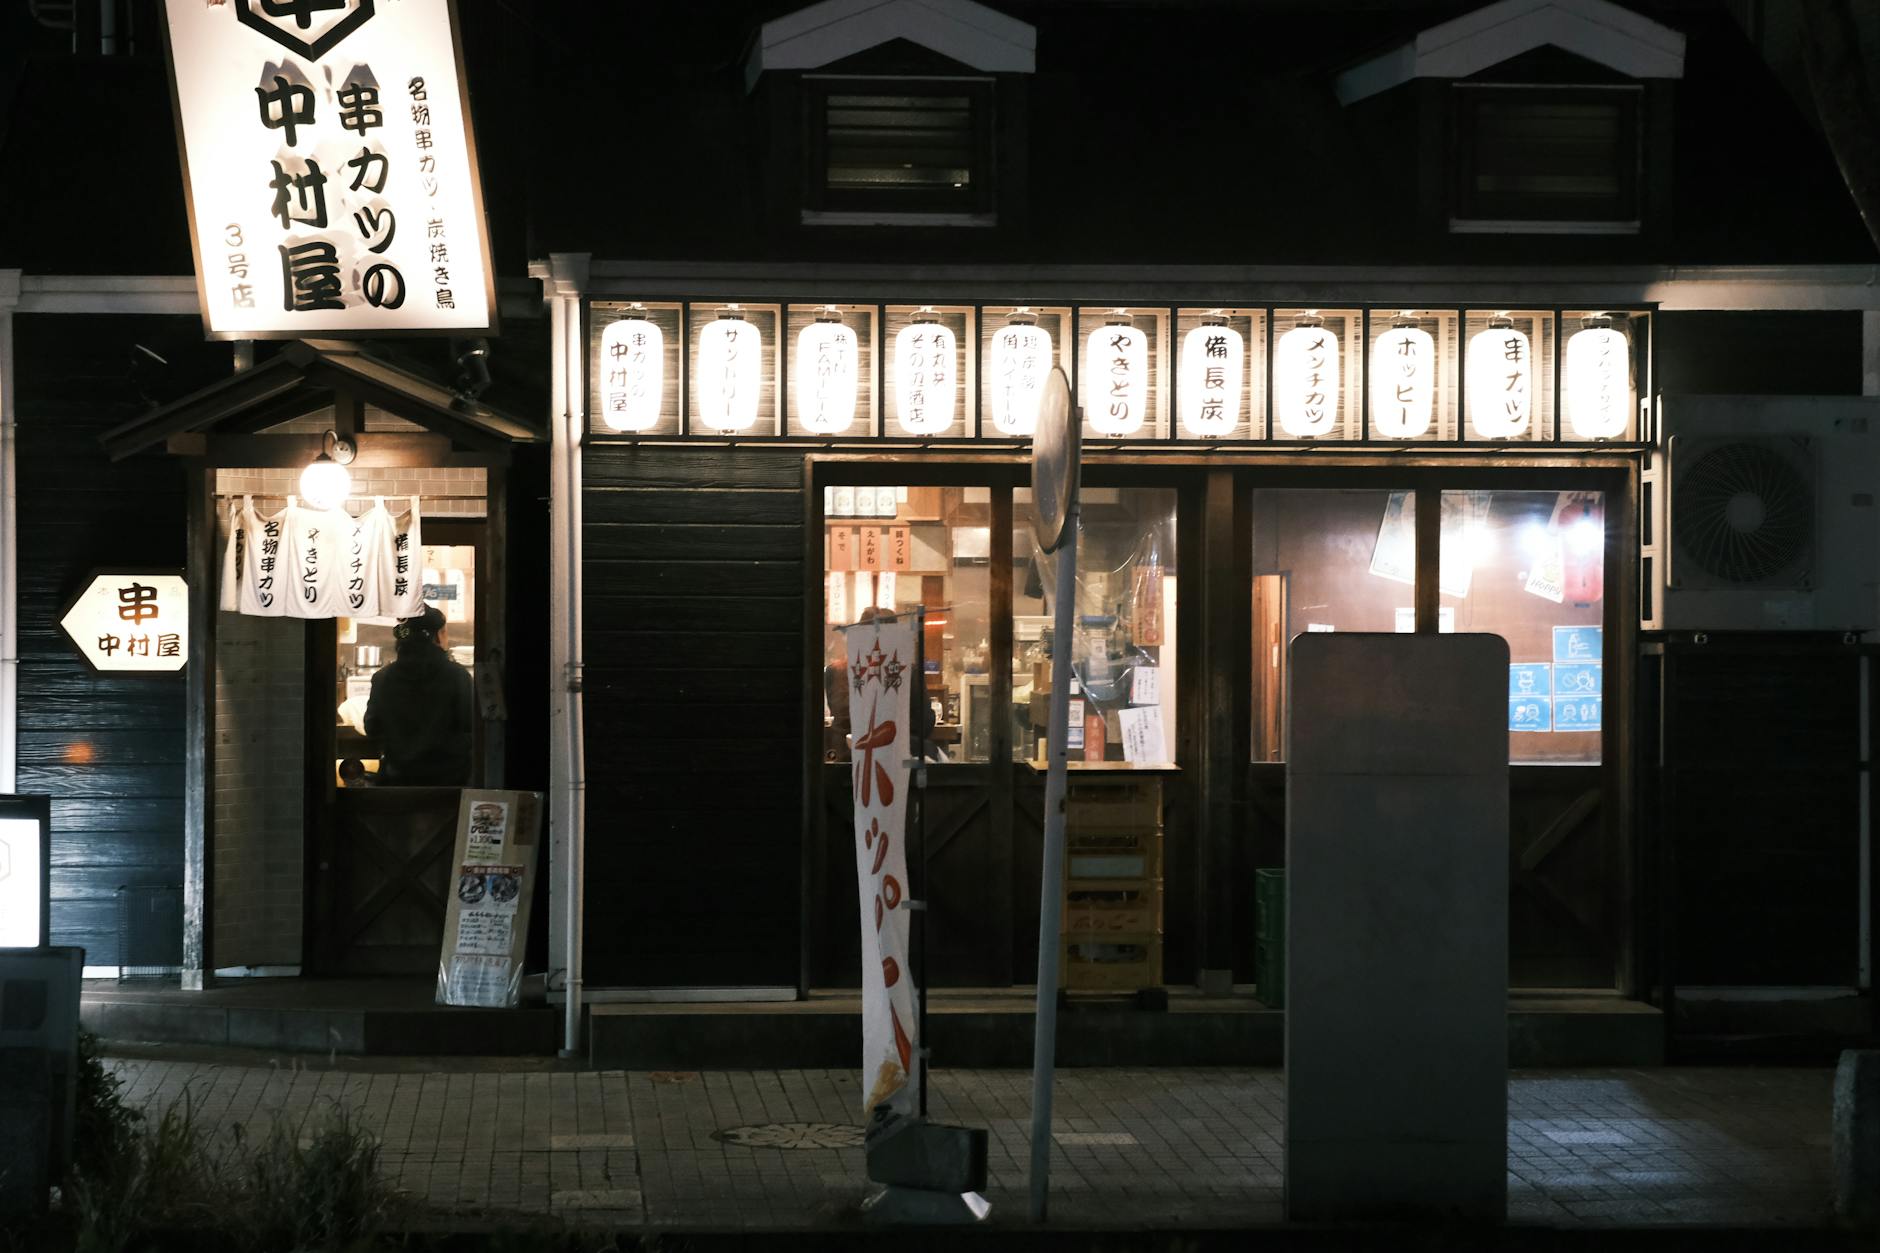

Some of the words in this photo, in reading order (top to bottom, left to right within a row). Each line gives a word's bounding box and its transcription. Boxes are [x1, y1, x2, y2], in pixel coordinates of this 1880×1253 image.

[254, 75, 346, 312] 中村屋
[336, 83, 406, 311] 串カツの
[224, 222, 255, 309] 3号店
[609, 341, 628, 412] 中村屋
[1109, 334, 1131, 420] やきとり
[1200, 335, 1228, 421] 備長炭
[1304, 337, 1326, 424] メンチカツ
[258, 520, 279, 608] 名物串カツ
[303, 527, 321, 603] やきとり
[349, 525, 364, 609] メンチカツ
[866, 530, 875, 564] えんがわ
[97, 633, 181, 656] 中村屋
[118, 582, 159, 625] 串
